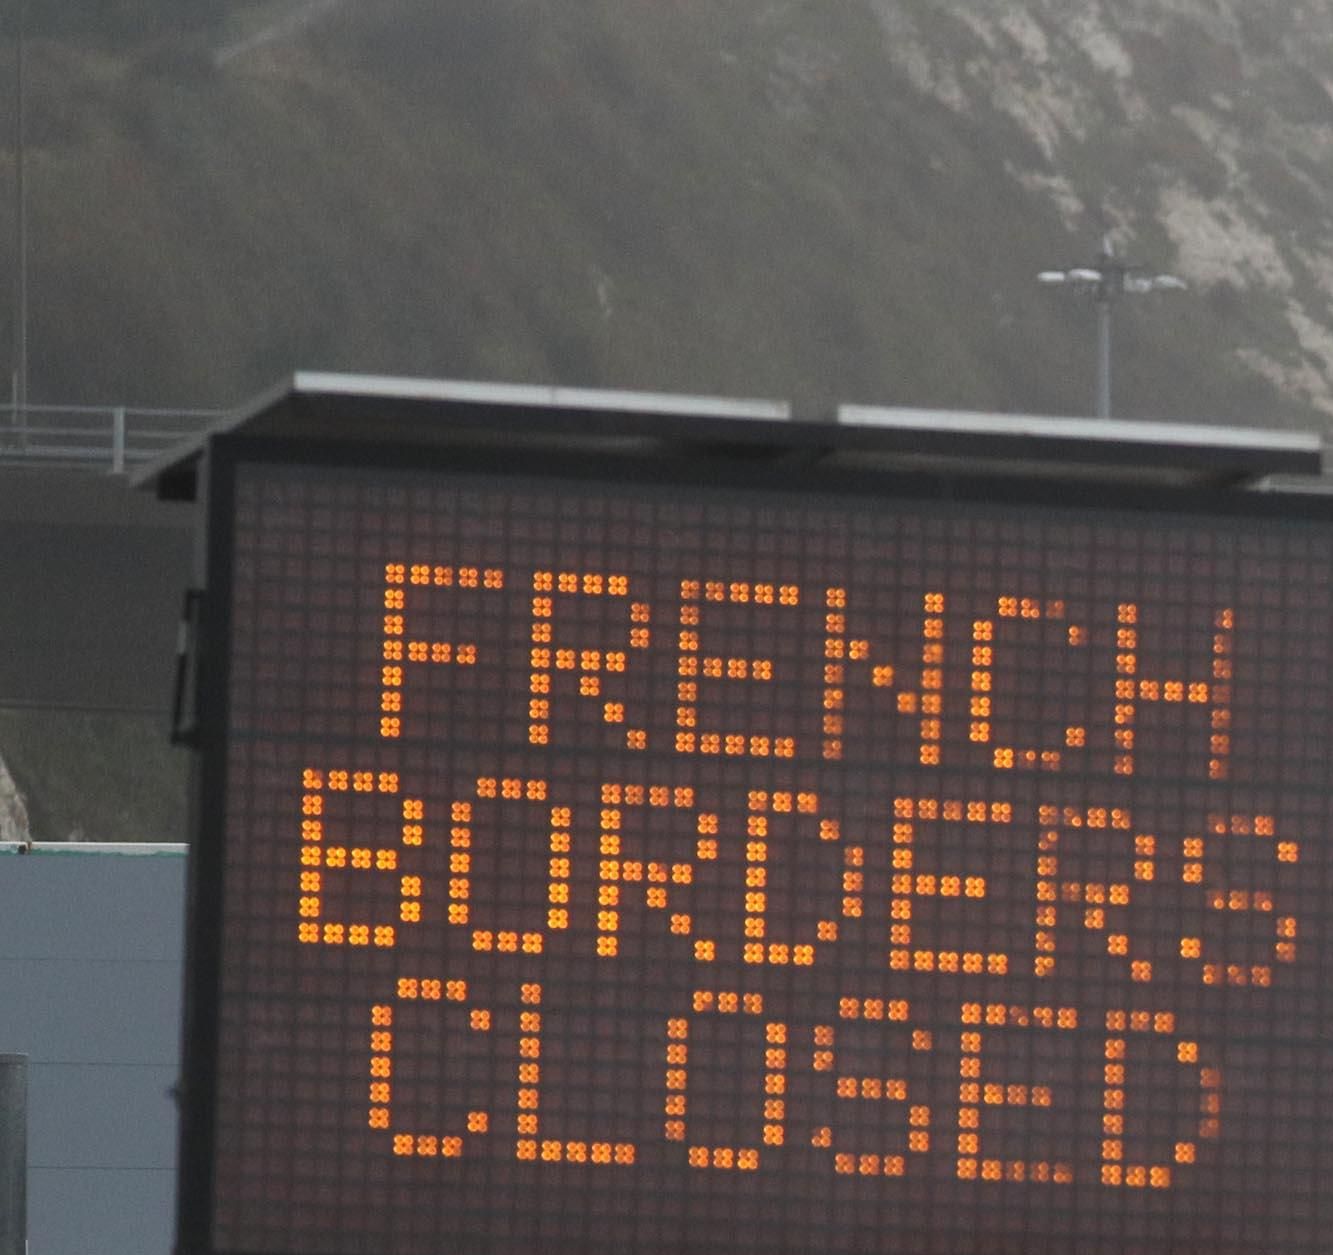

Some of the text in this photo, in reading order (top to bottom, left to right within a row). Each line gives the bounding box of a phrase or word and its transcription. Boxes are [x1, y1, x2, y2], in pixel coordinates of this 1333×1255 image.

[380, 562, 1233, 777] FRENCH
[299, 768, 1299, 986] BORDERS
[369, 977, 1219, 1188] CLOSED
